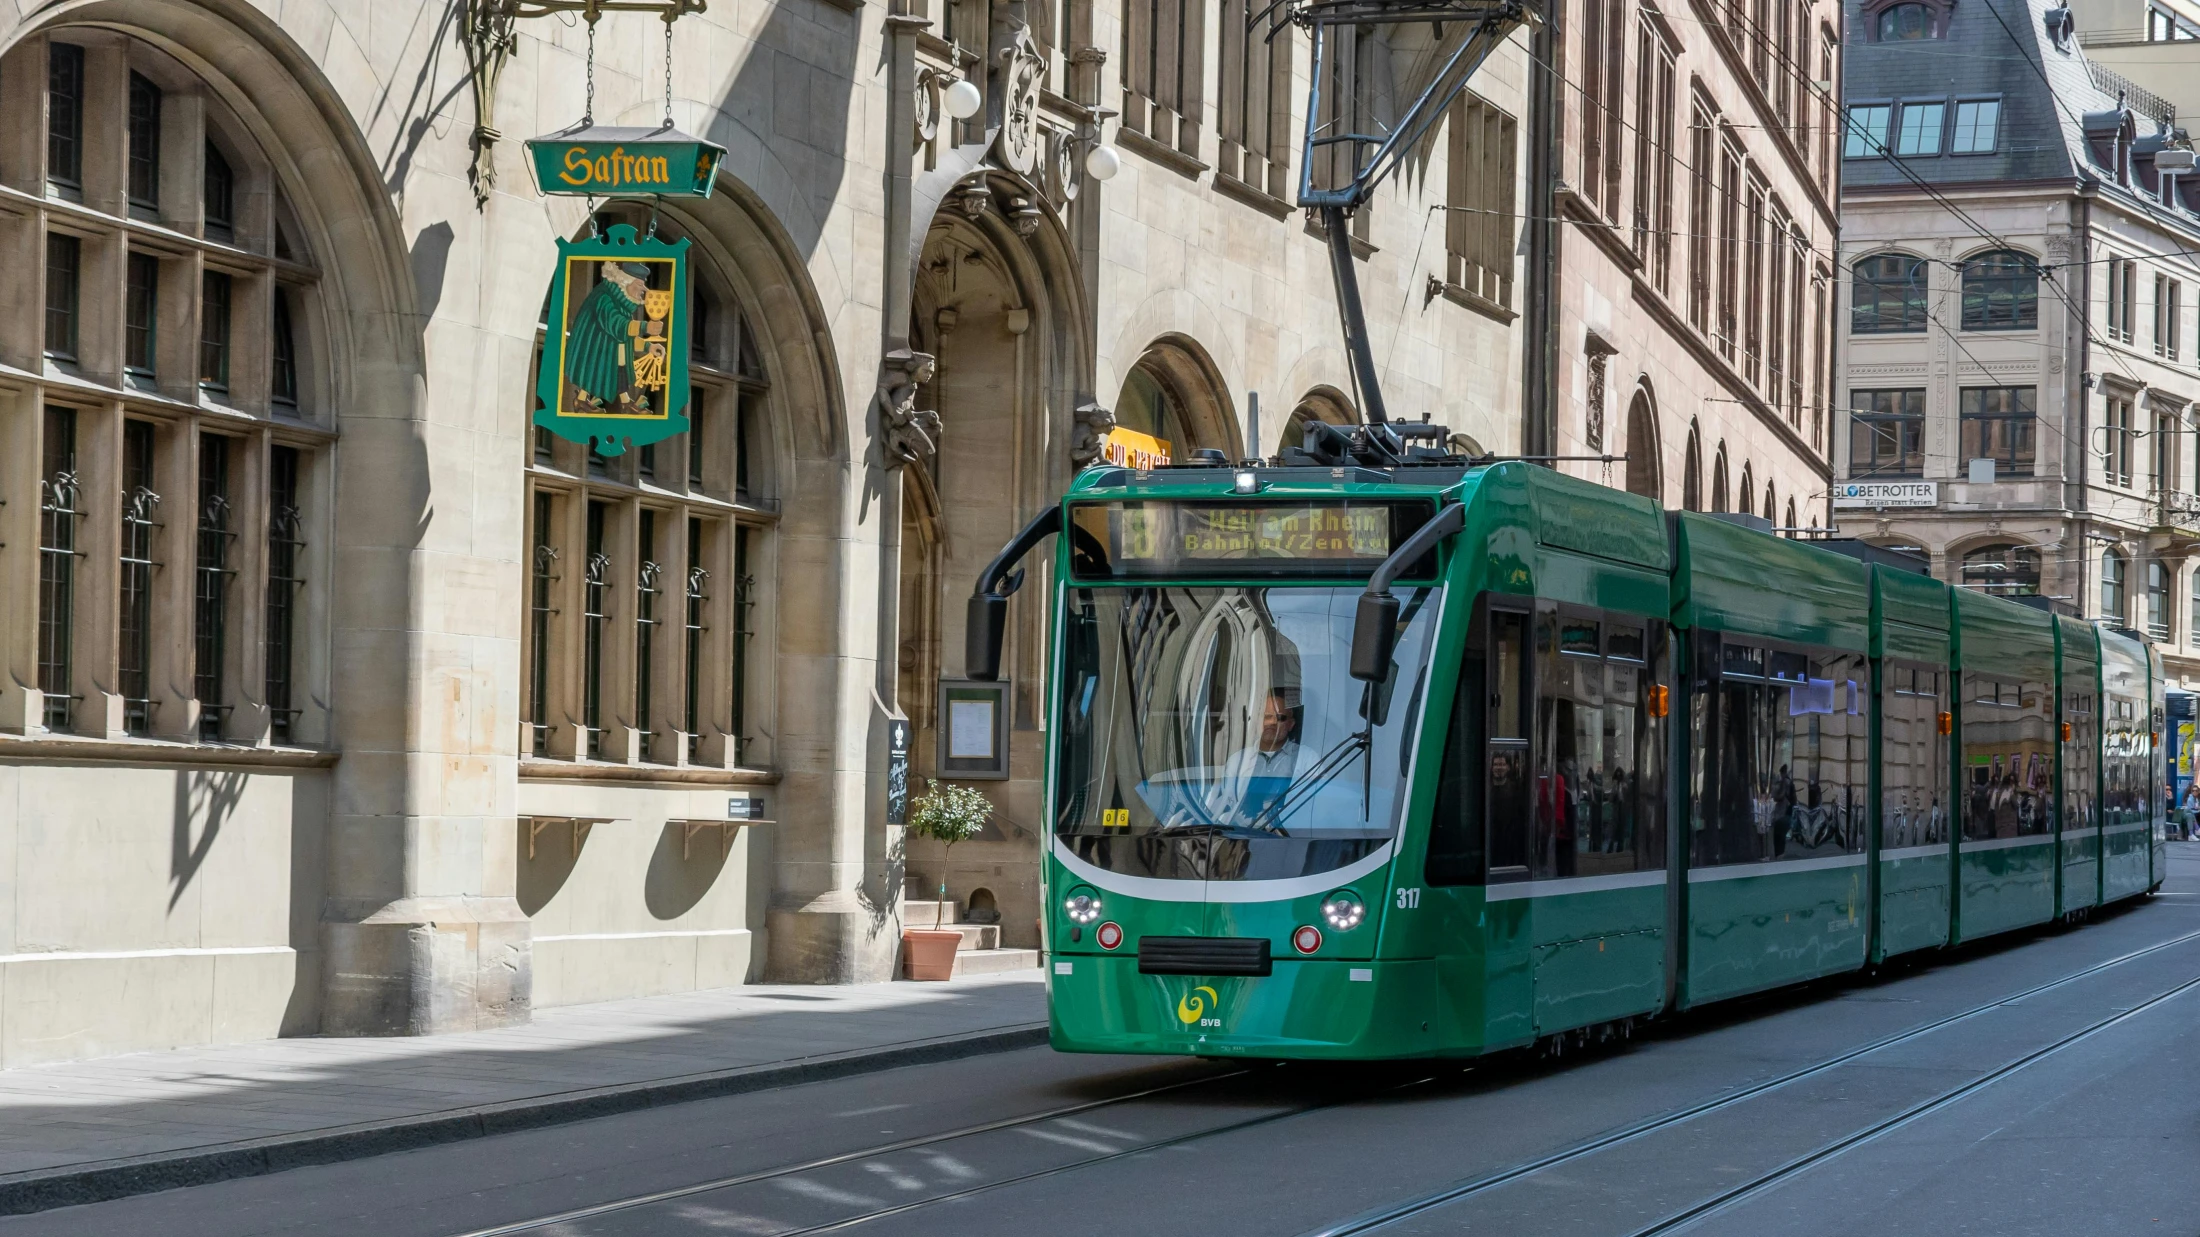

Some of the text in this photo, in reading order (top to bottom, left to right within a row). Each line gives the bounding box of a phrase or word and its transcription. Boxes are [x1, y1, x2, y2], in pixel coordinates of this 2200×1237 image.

[559, 146, 670, 187] Safran
[1267, 515, 1299, 531] am
[1310, 509, 1376, 532] Rhein
[1396, 887, 1420, 909] 317
[1200, 1018, 1221, 1027] BVB
